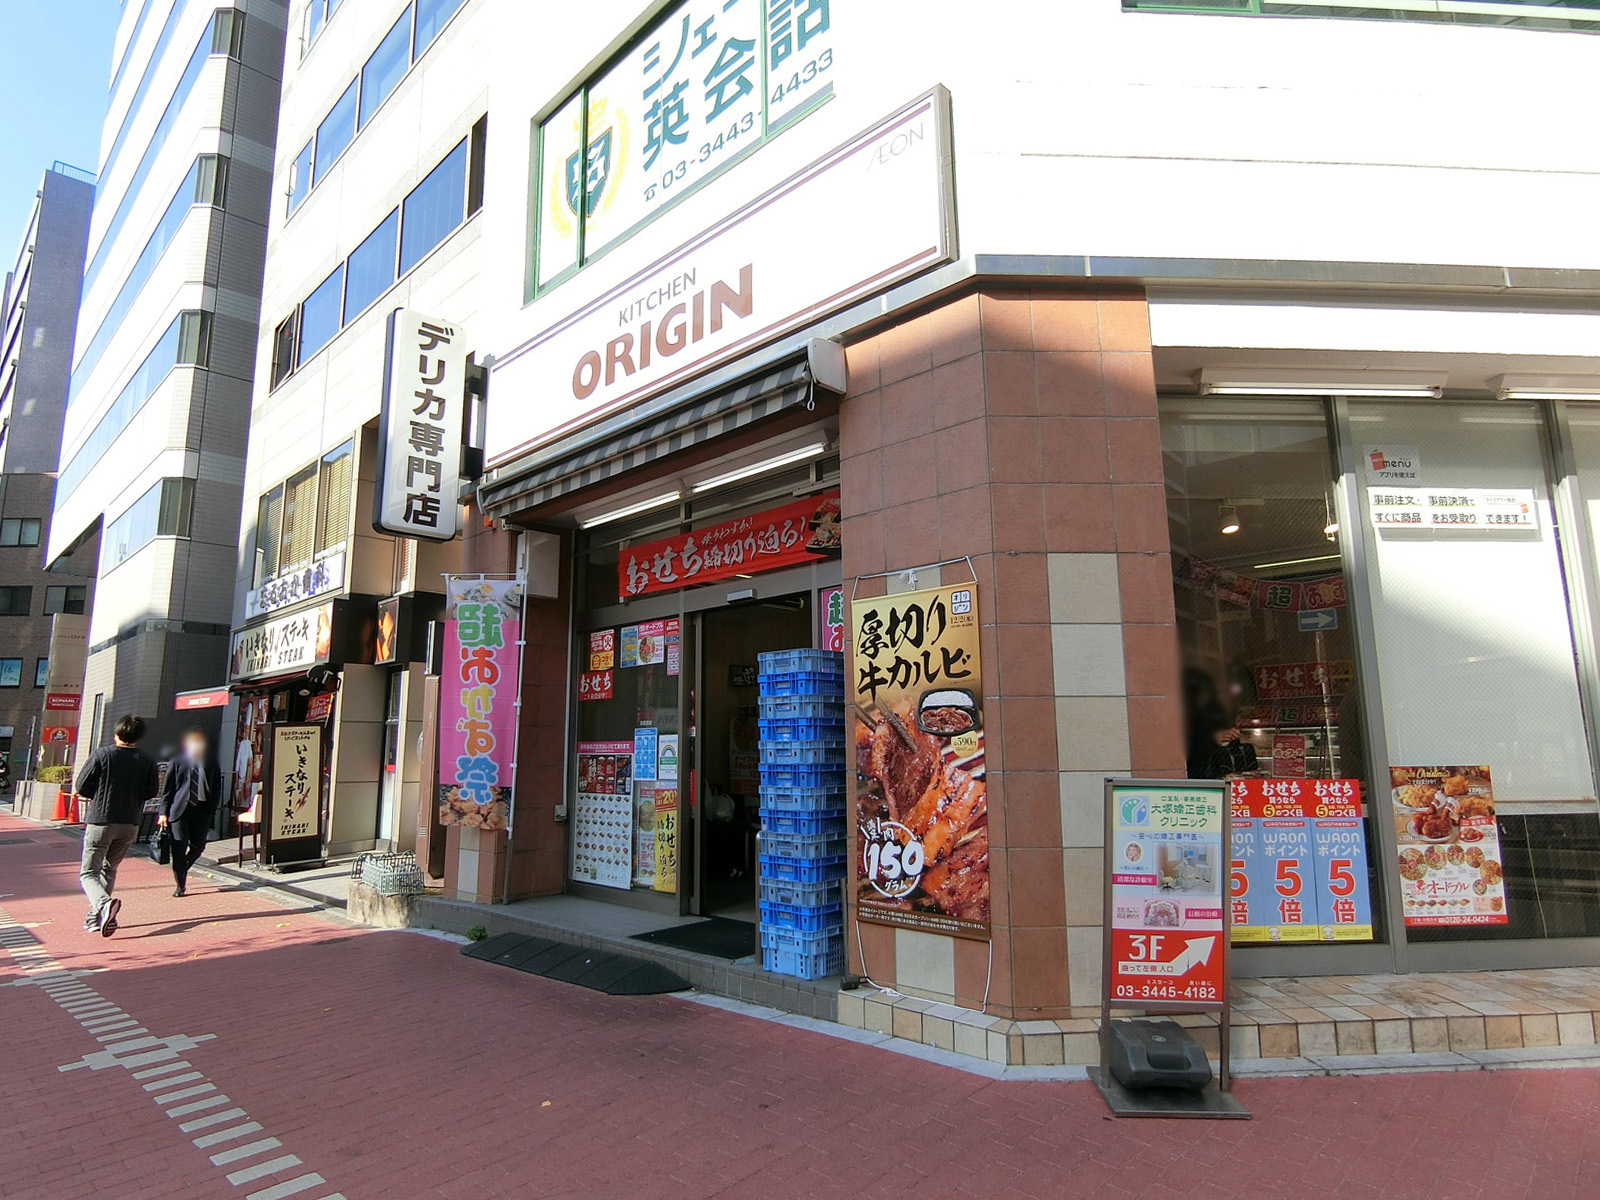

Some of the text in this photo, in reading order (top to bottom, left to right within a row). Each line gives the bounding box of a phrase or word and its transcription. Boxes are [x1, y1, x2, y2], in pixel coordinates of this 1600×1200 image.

[643, 0, 742, 101] シェ
[662, 48, 833, 190] 03-3443-4433
[619, 267, 697, 327] KITCHEN
[572, 263, 753, 400] ORIGIN
[402, 321, 455, 528] デリカ専門店
[1382, 460, 1411, 468] menu
[1375, 513, 1422, 523] すぐに商品
[1432, 513, 1476, 523] をお受取り
[856, 595, 947, 659] 厚切り
[278, 646, 304, 665] STEAK
[580, 672, 612, 693] おせち
[857, 647, 972, 703] 牛カルビ
[1259, 666, 1329, 690] おせち
[285, 774, 297, 819] ステーキ
[1262, 780, 1301, 796] おせち
[1314, 780, 1353, 796] おせち
[1151, 804, 1217, 816] 大塚矯正歯科
[281, 828, 307, 836] STEAK
[1160, 817, 1208, 827] クリニック
[665, 813, 677, 867] おせち
[1263, 832, 1307, 844] WAON
[1316, 832, 1360, 844] WAON
[868, 841, 925, 881] 150
[1265, 845, 1308, 857] ポイント
[1318, 845, 1360, 857] ポイント
[885, 880, 908, 891] グラム
[1275, 859, 1302, 897] 5
[1328, 859, 1355, 897] 5
[1427, 880, 1471, 895] オードブル
[1277, 899, 1302, 924] 倍
[1332, 899, 1356, 924] 倍
[1445, 915, 1489, 924] 0120-24-0424
[1128, 934, 1165, 960] 3F
[1116, 985, 1216, 999] 03-3445-4182
